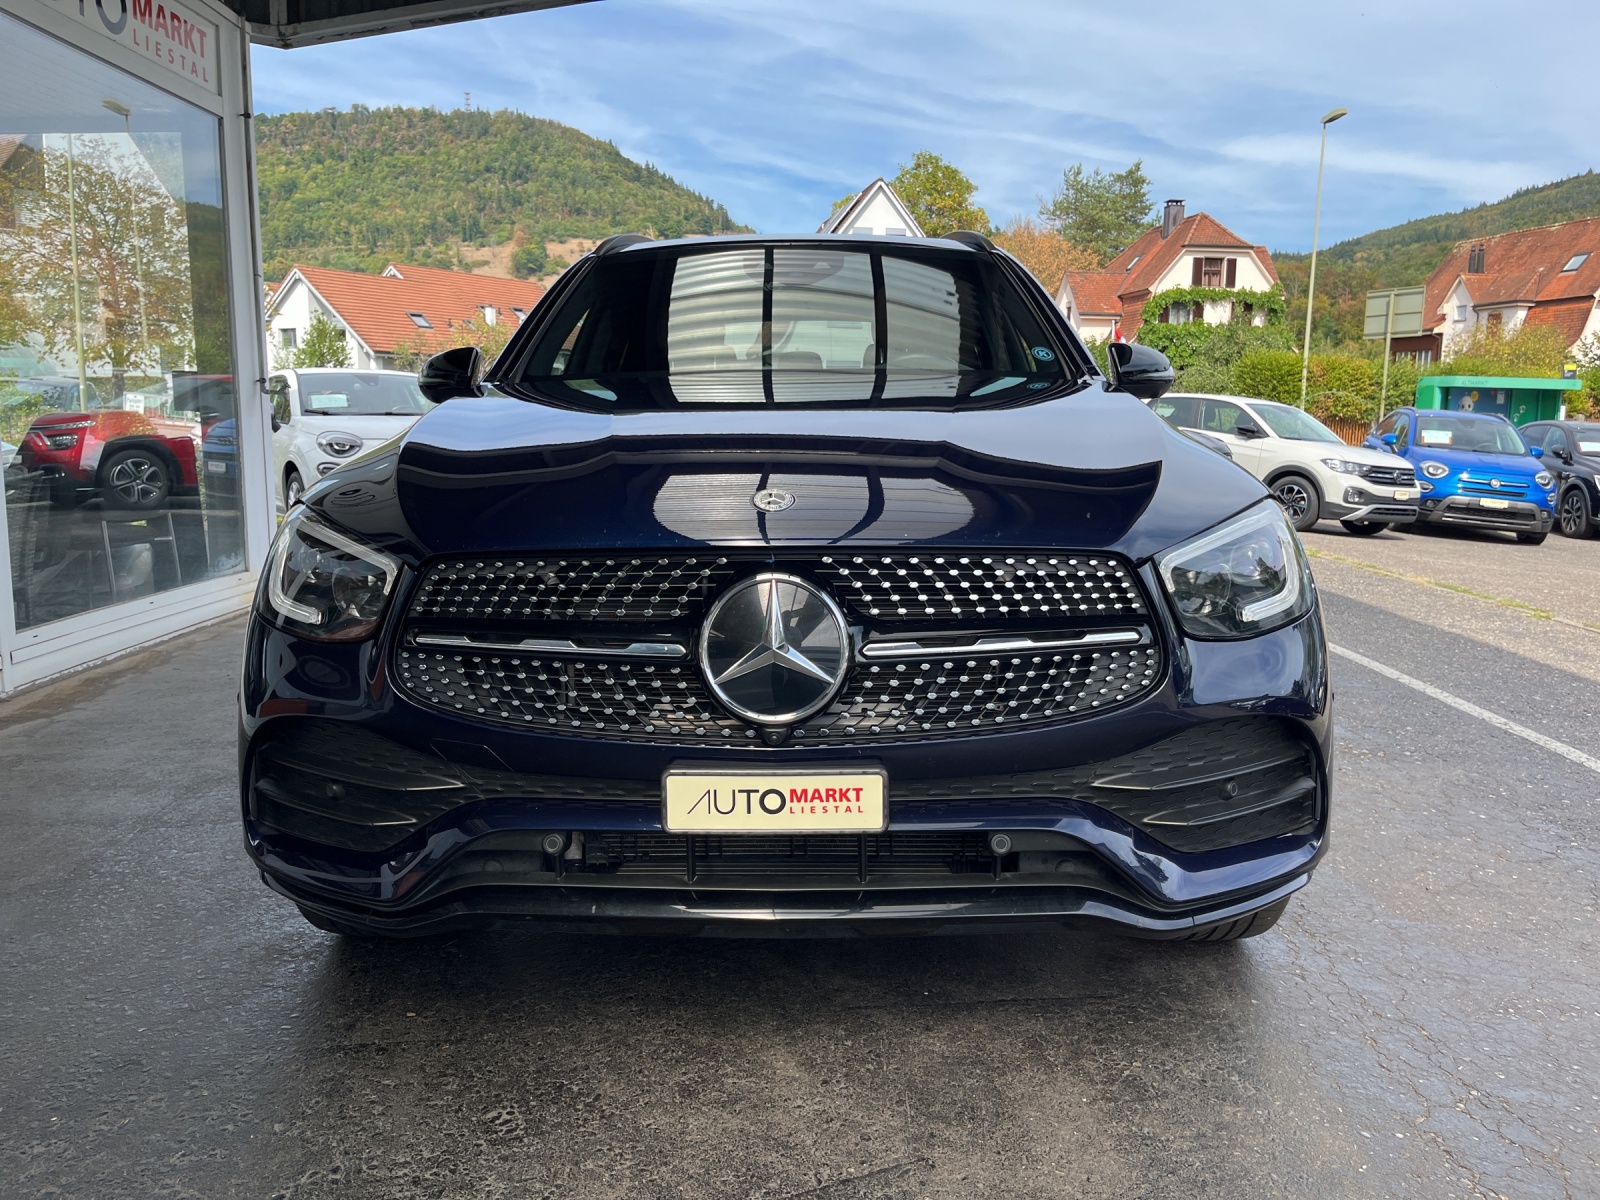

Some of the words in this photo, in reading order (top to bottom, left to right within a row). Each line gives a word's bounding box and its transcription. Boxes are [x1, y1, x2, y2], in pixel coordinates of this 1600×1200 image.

[132, 0, 207, 58] MARKT
[133, 28, 208, 82] LIESTAL
[790, 805, 863, 814] LIESTAL
